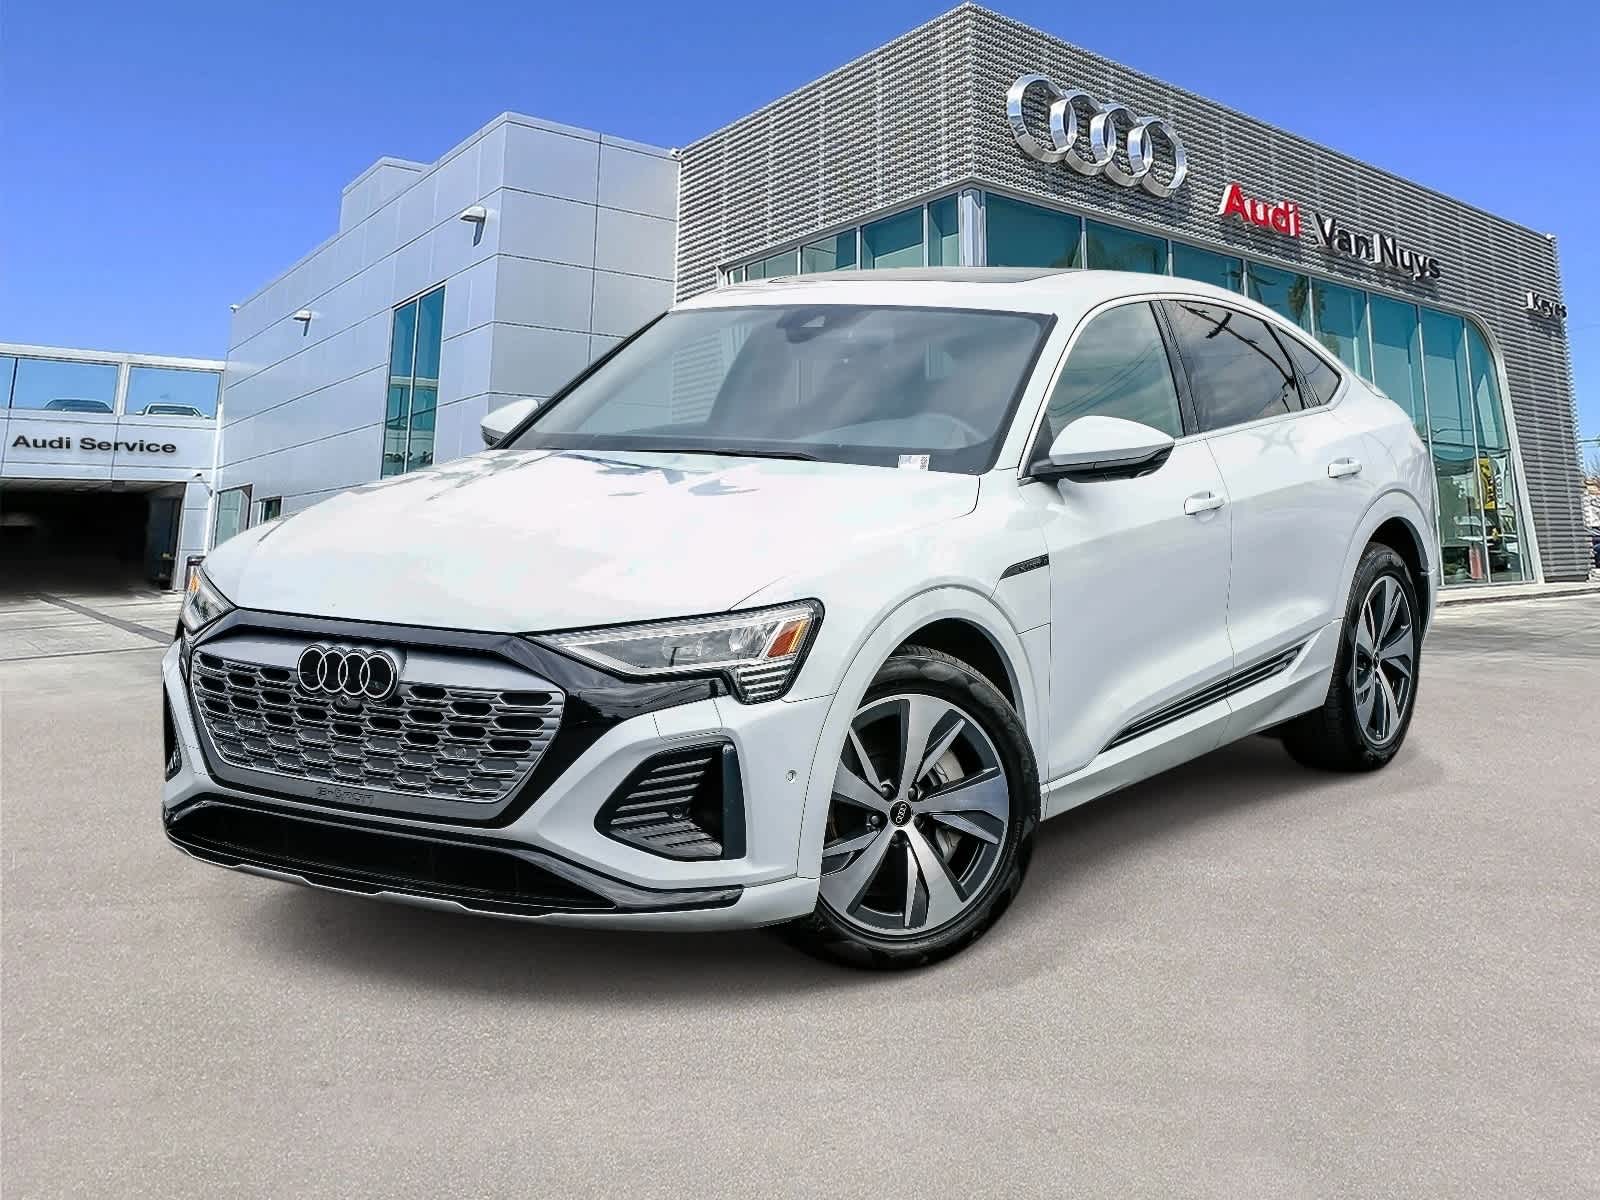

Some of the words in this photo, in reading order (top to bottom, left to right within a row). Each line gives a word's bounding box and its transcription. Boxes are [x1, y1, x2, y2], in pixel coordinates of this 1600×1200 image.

[1217, 182, 1301, 238] Audi
[1311, 211, 1372, 261] Van
[1372, 232, 1441, 281] Nuys
[12, 434, 71, 449] Audi
[79, 437, 177, 454] Service
